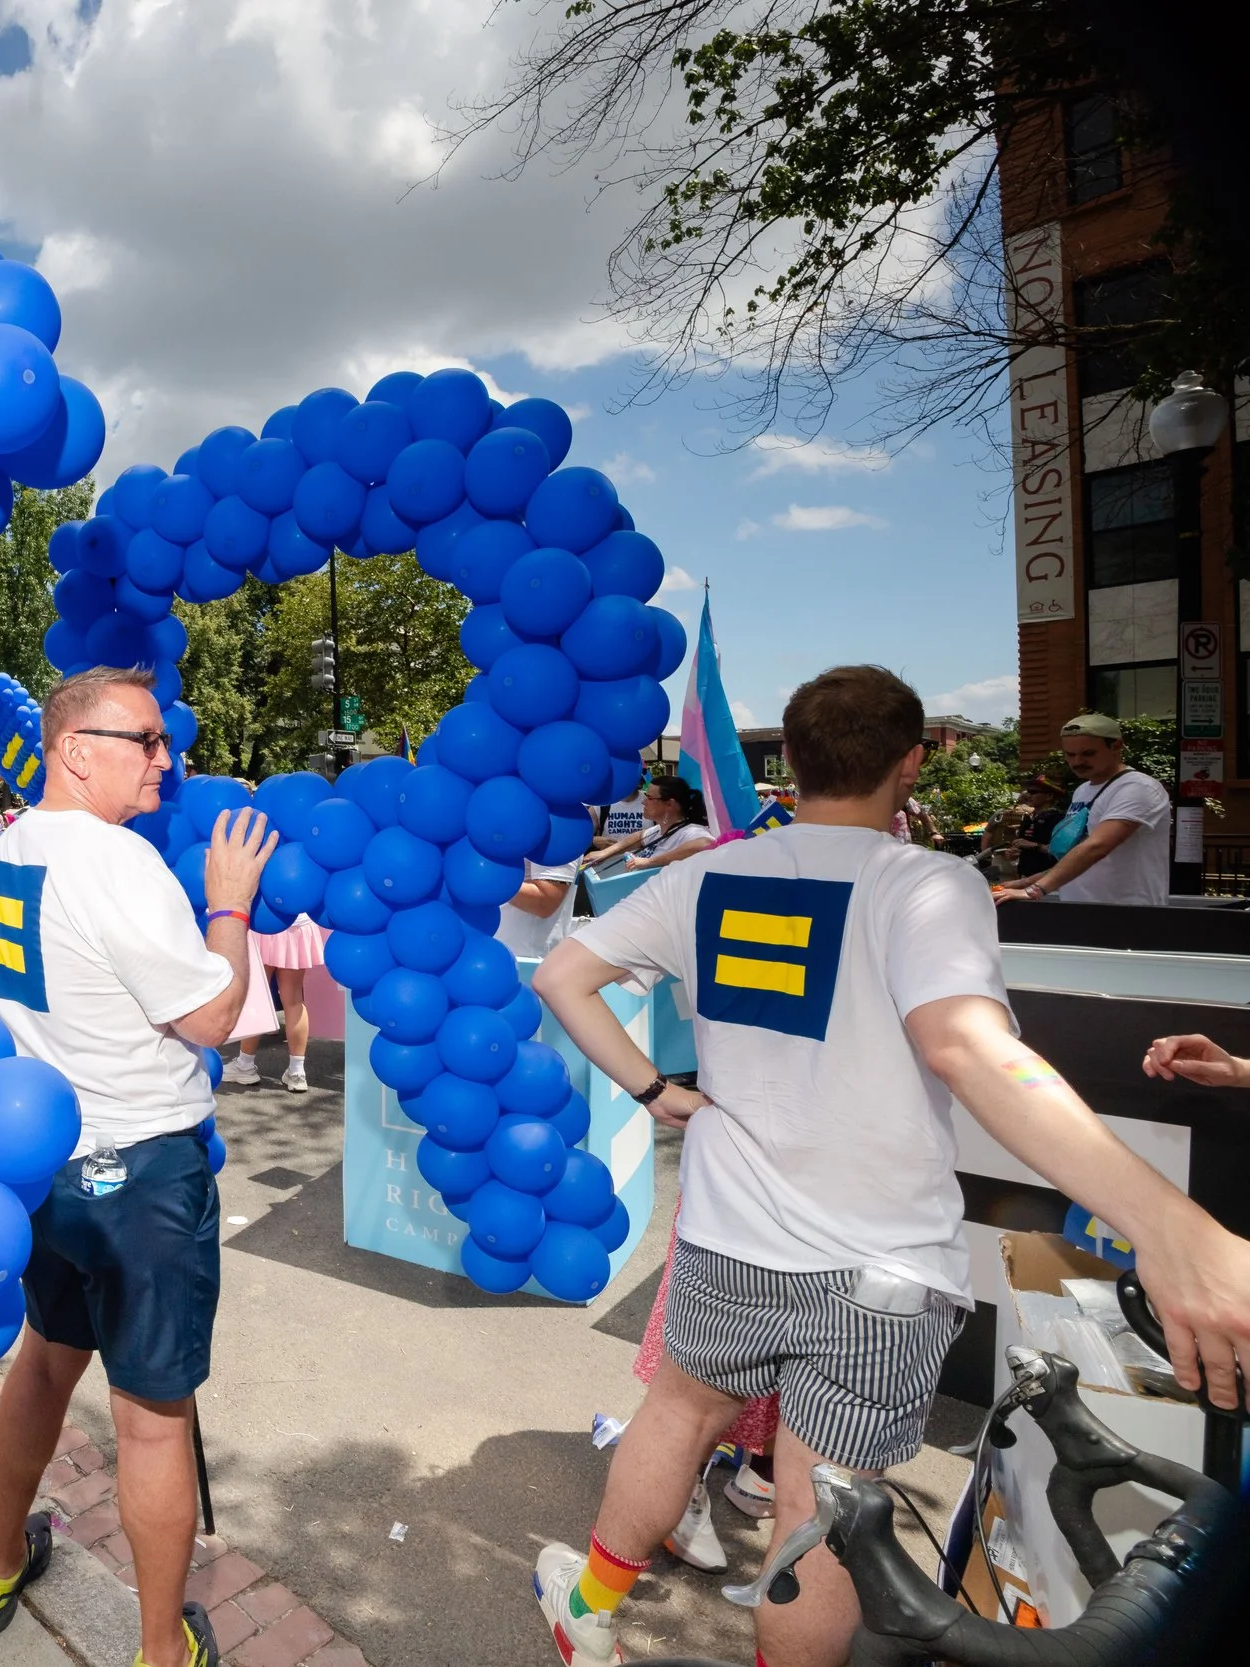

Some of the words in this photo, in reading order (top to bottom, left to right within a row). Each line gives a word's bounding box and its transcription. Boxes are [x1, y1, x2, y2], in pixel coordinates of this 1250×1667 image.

[1018, 368, 1065, 583] LEASING
[345, 700, 350, 708] S
[608, 812, 643, 820] HUMAN
[608, 820, 643, 828] RIGHTS
[386, 1183, 448, 1216] RIG
[386, 1218, 458, 1245] CAMP
